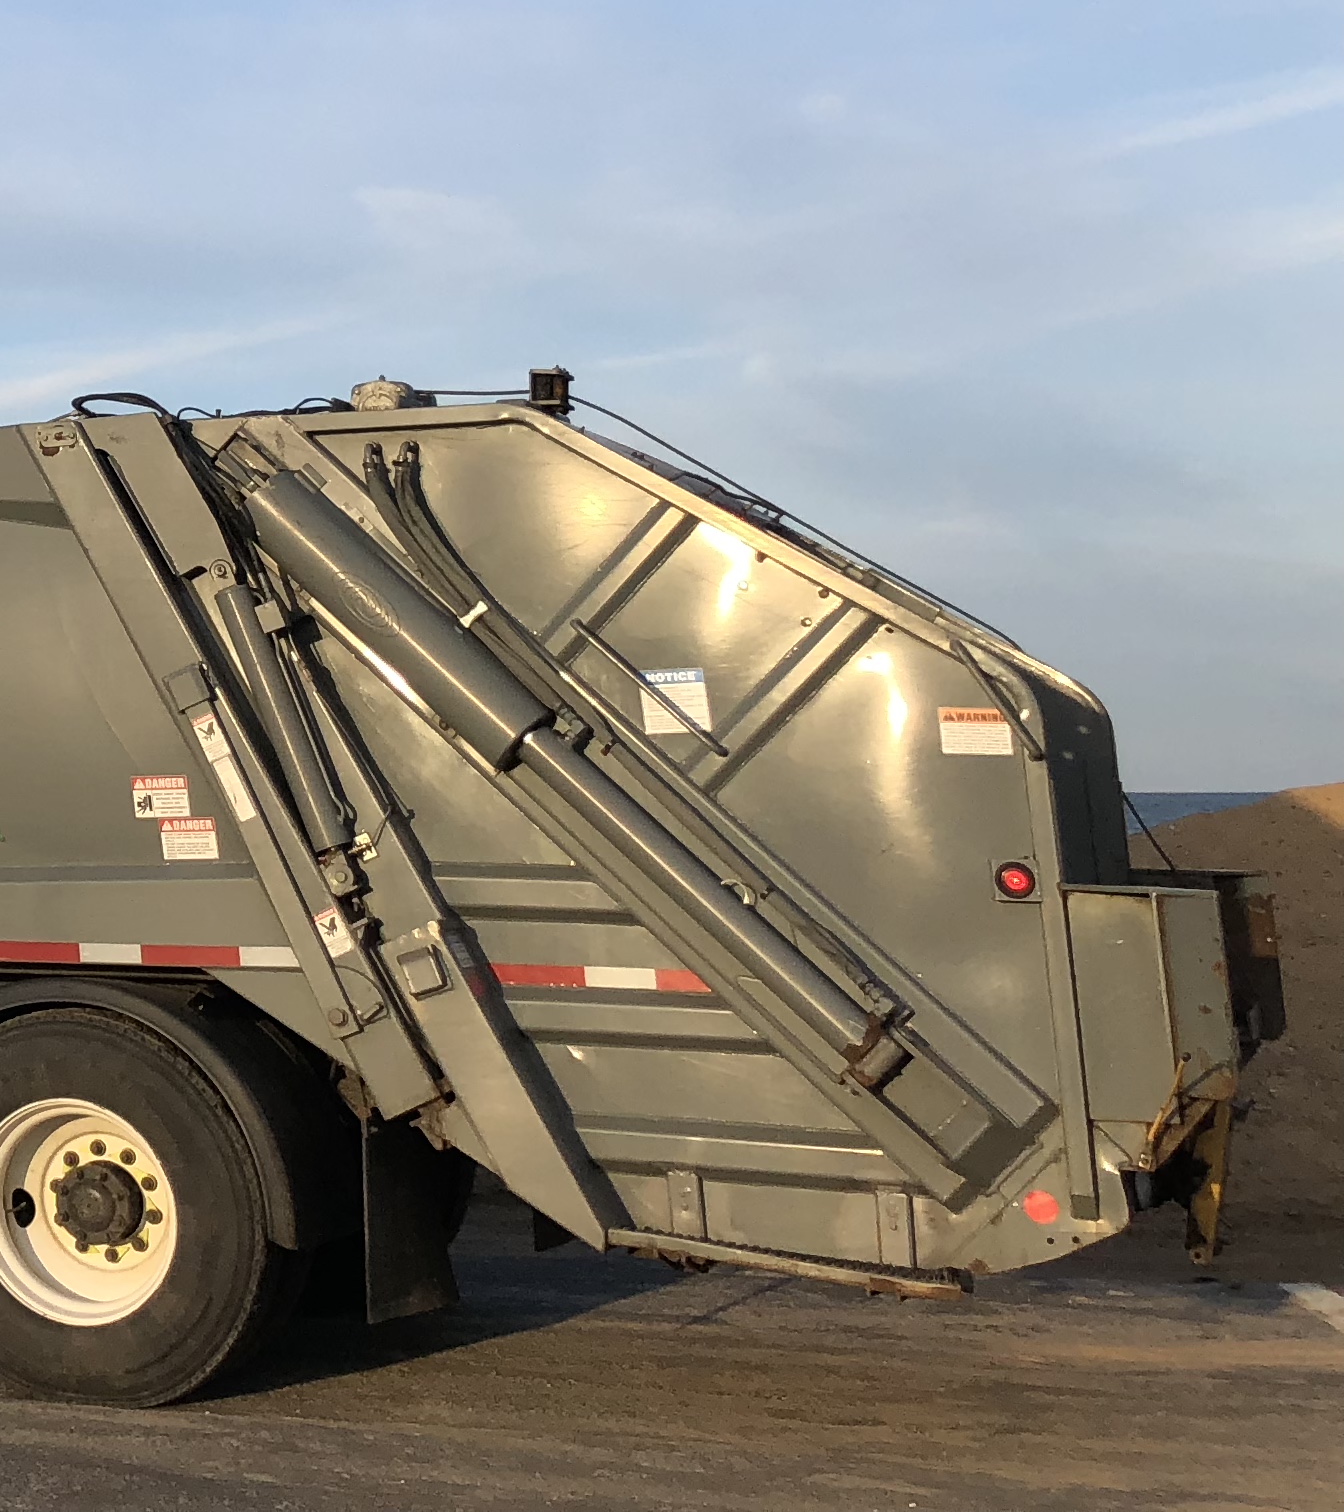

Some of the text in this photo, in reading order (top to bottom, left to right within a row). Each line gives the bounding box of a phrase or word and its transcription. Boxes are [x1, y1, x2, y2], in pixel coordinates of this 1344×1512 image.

[645, 671, 697, 683] NOTICE
[145, 777, 185, 789] DANGER
[172, 819, 214, 831] DANGER
